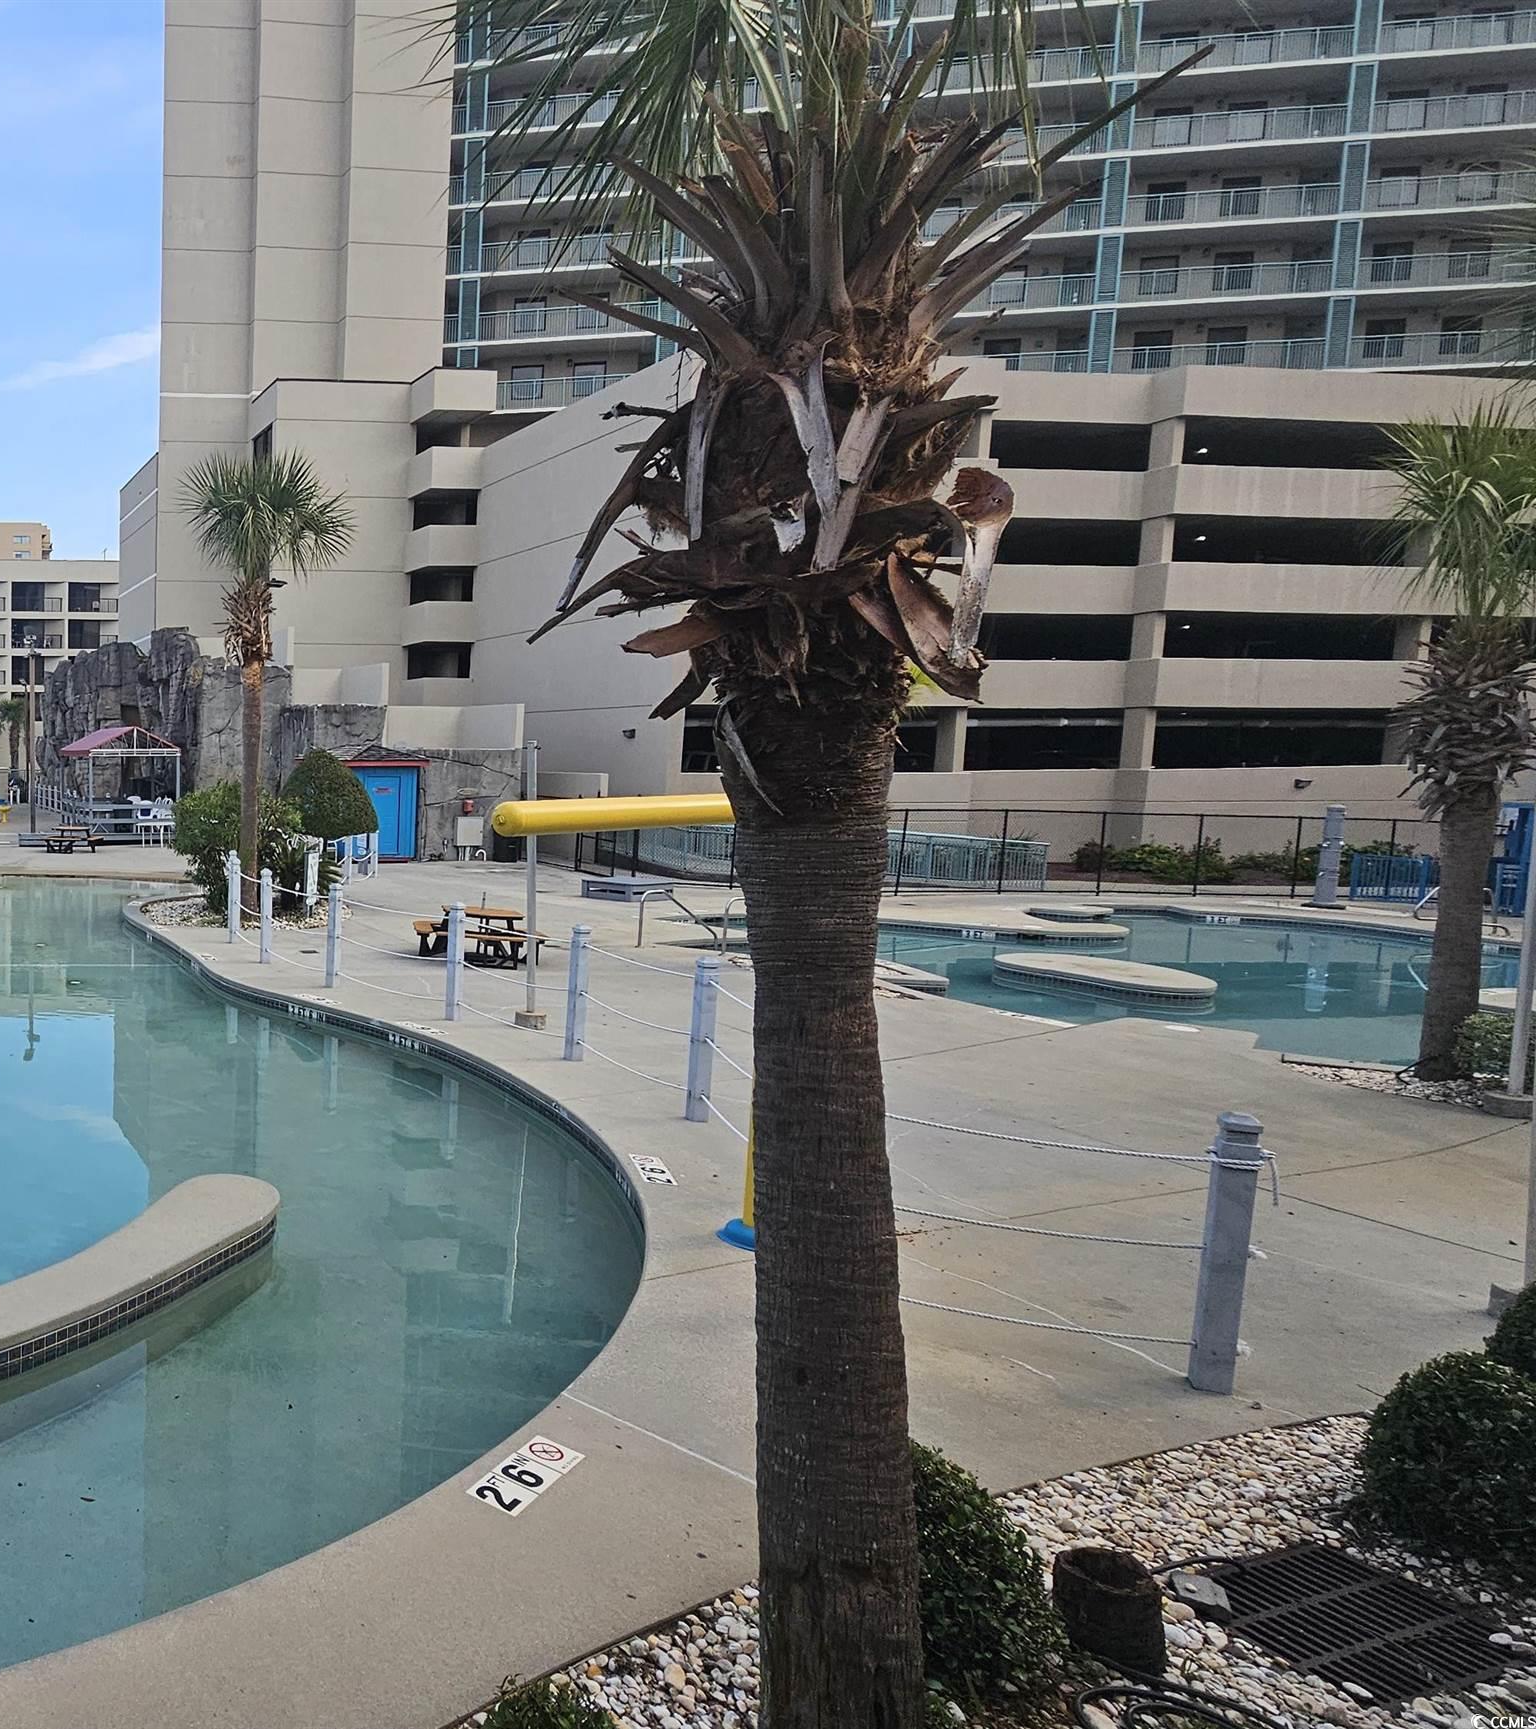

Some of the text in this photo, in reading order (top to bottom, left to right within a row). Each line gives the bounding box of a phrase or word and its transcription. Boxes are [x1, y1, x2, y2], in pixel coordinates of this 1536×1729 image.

[476, 1454, 544, 1512] 2 FT 6 IN
